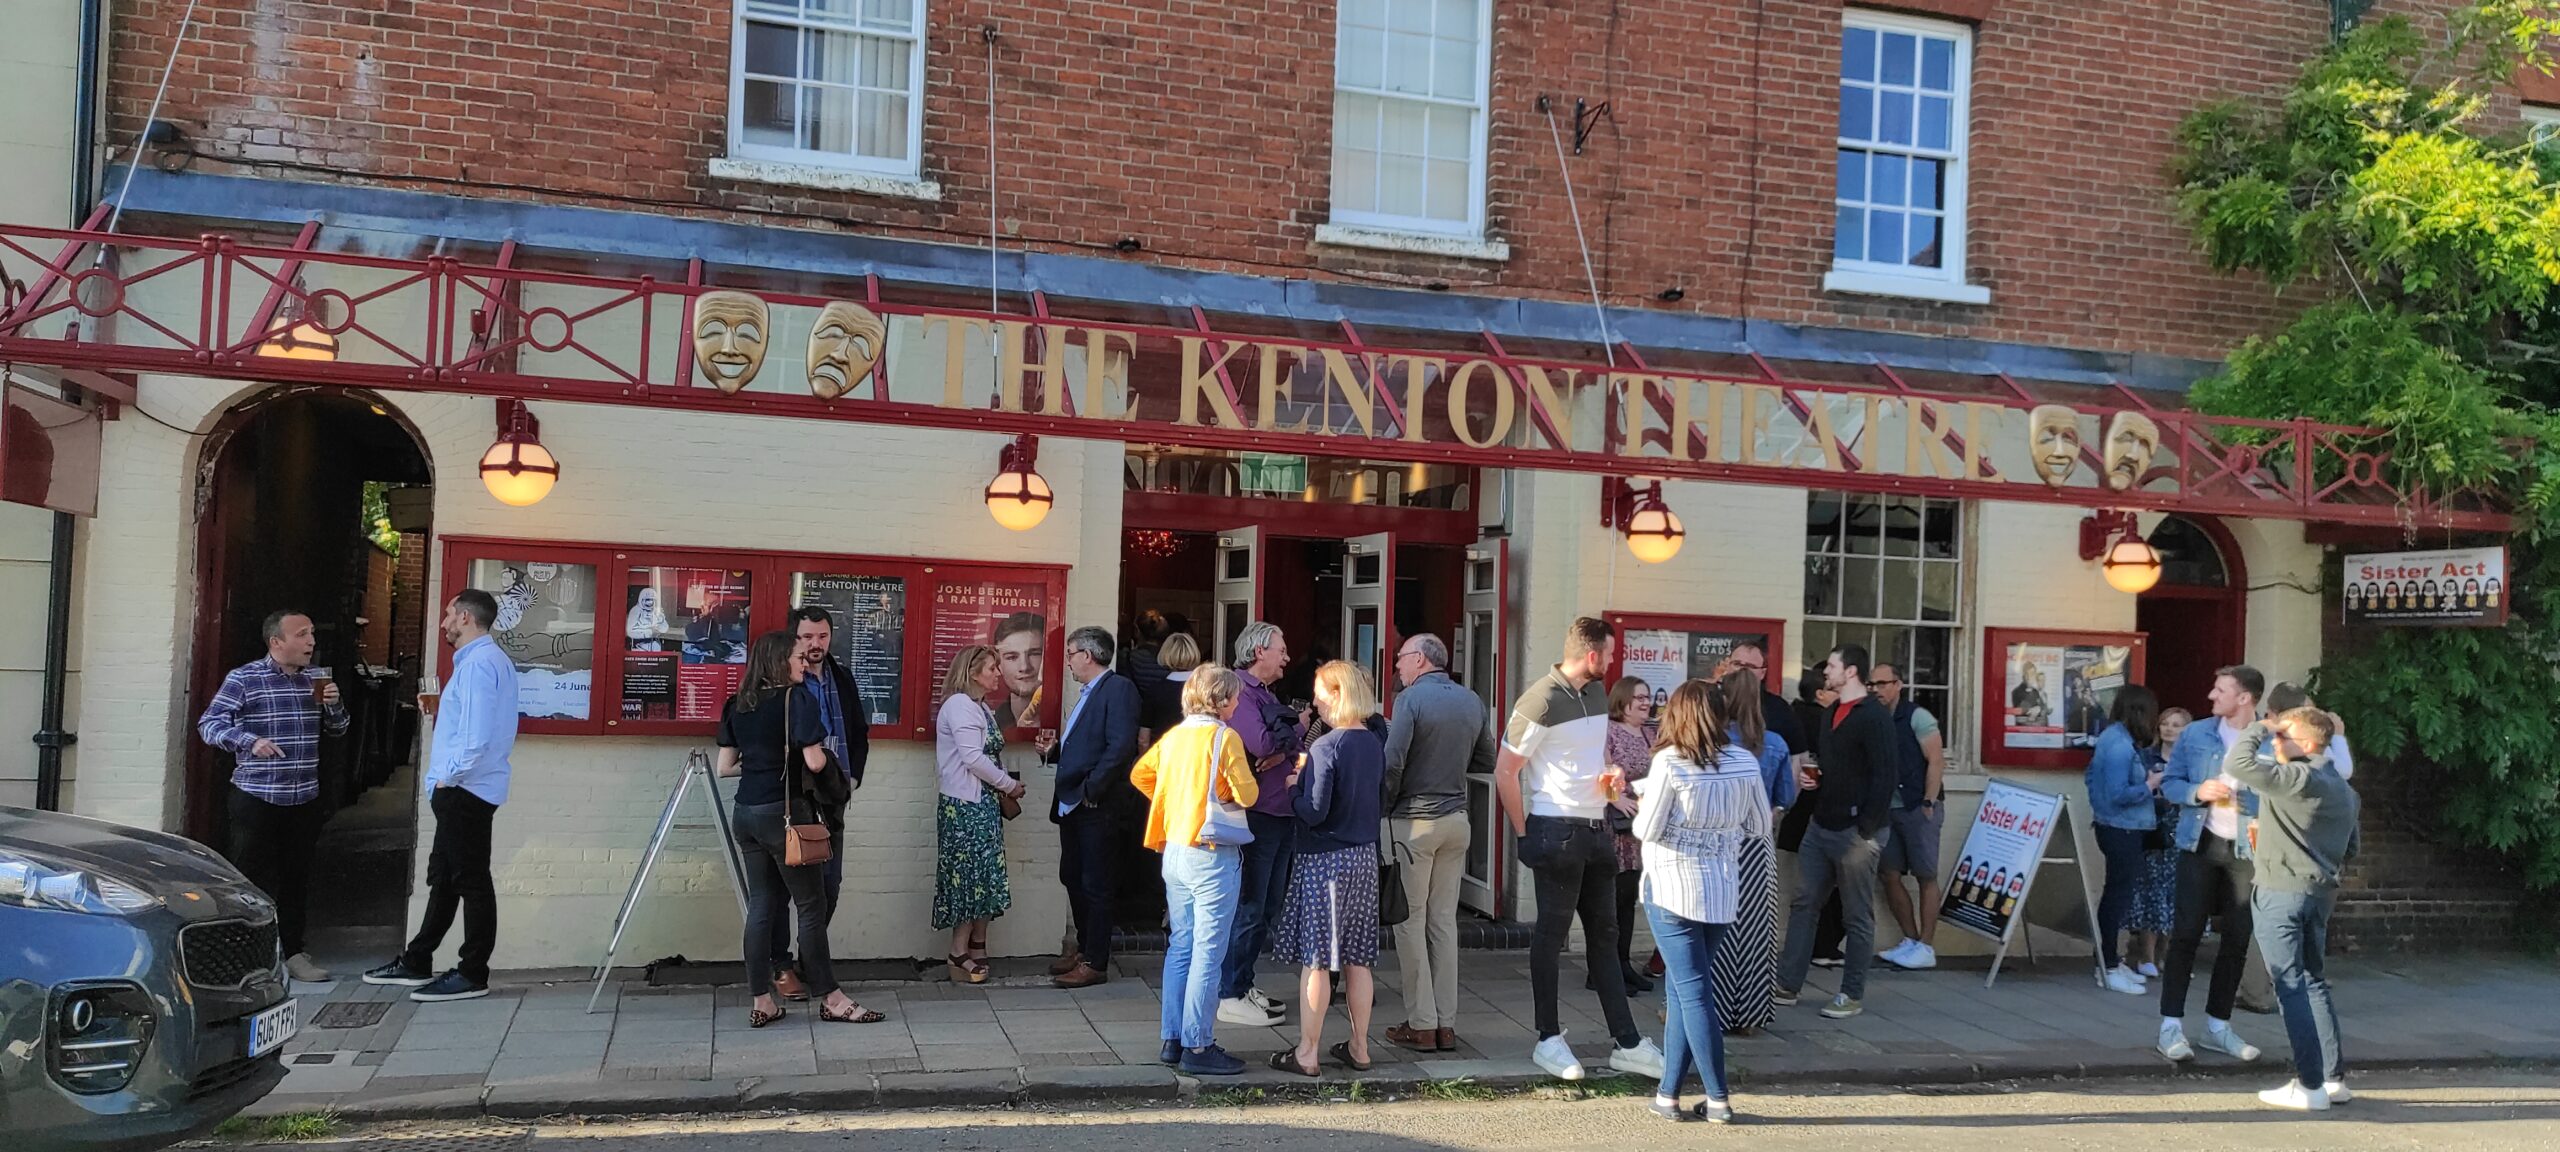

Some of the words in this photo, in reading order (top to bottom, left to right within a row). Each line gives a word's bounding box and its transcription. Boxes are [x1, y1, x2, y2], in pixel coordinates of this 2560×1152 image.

[923, 313, 1140, 423] THE
[1170, 336, 1582, 451] KENTON
[1608, 372, 2005, 483] THEATRE
[2360, 565, 2432, 580] Sister
[2440, 561, 2486, 577] Act
[804, 580, 817, 588] HE
[820, 580, 859, 590] KENTON
[861, 582, 904, 592] THEATRE
[937, 585, 972, 595] JOSH
[978, 587, 1021, 597] BERRY
[936, 595, 944, 603] &
[951, 596, 985, 605] RAFE
[991, 597, 1040, 608] HUBRIS
[1699, 637, 1733, 646] JOHNNY
[1622, 644, 1658, 661] Sister
[1661, 646, 1684, 663] Act
[554, 682, 567, 690] 24
[621, 703, 641, 711] WAR
[1980, 800, 2017, 831] Sister
[2018, 812, 2046, 839] Act
